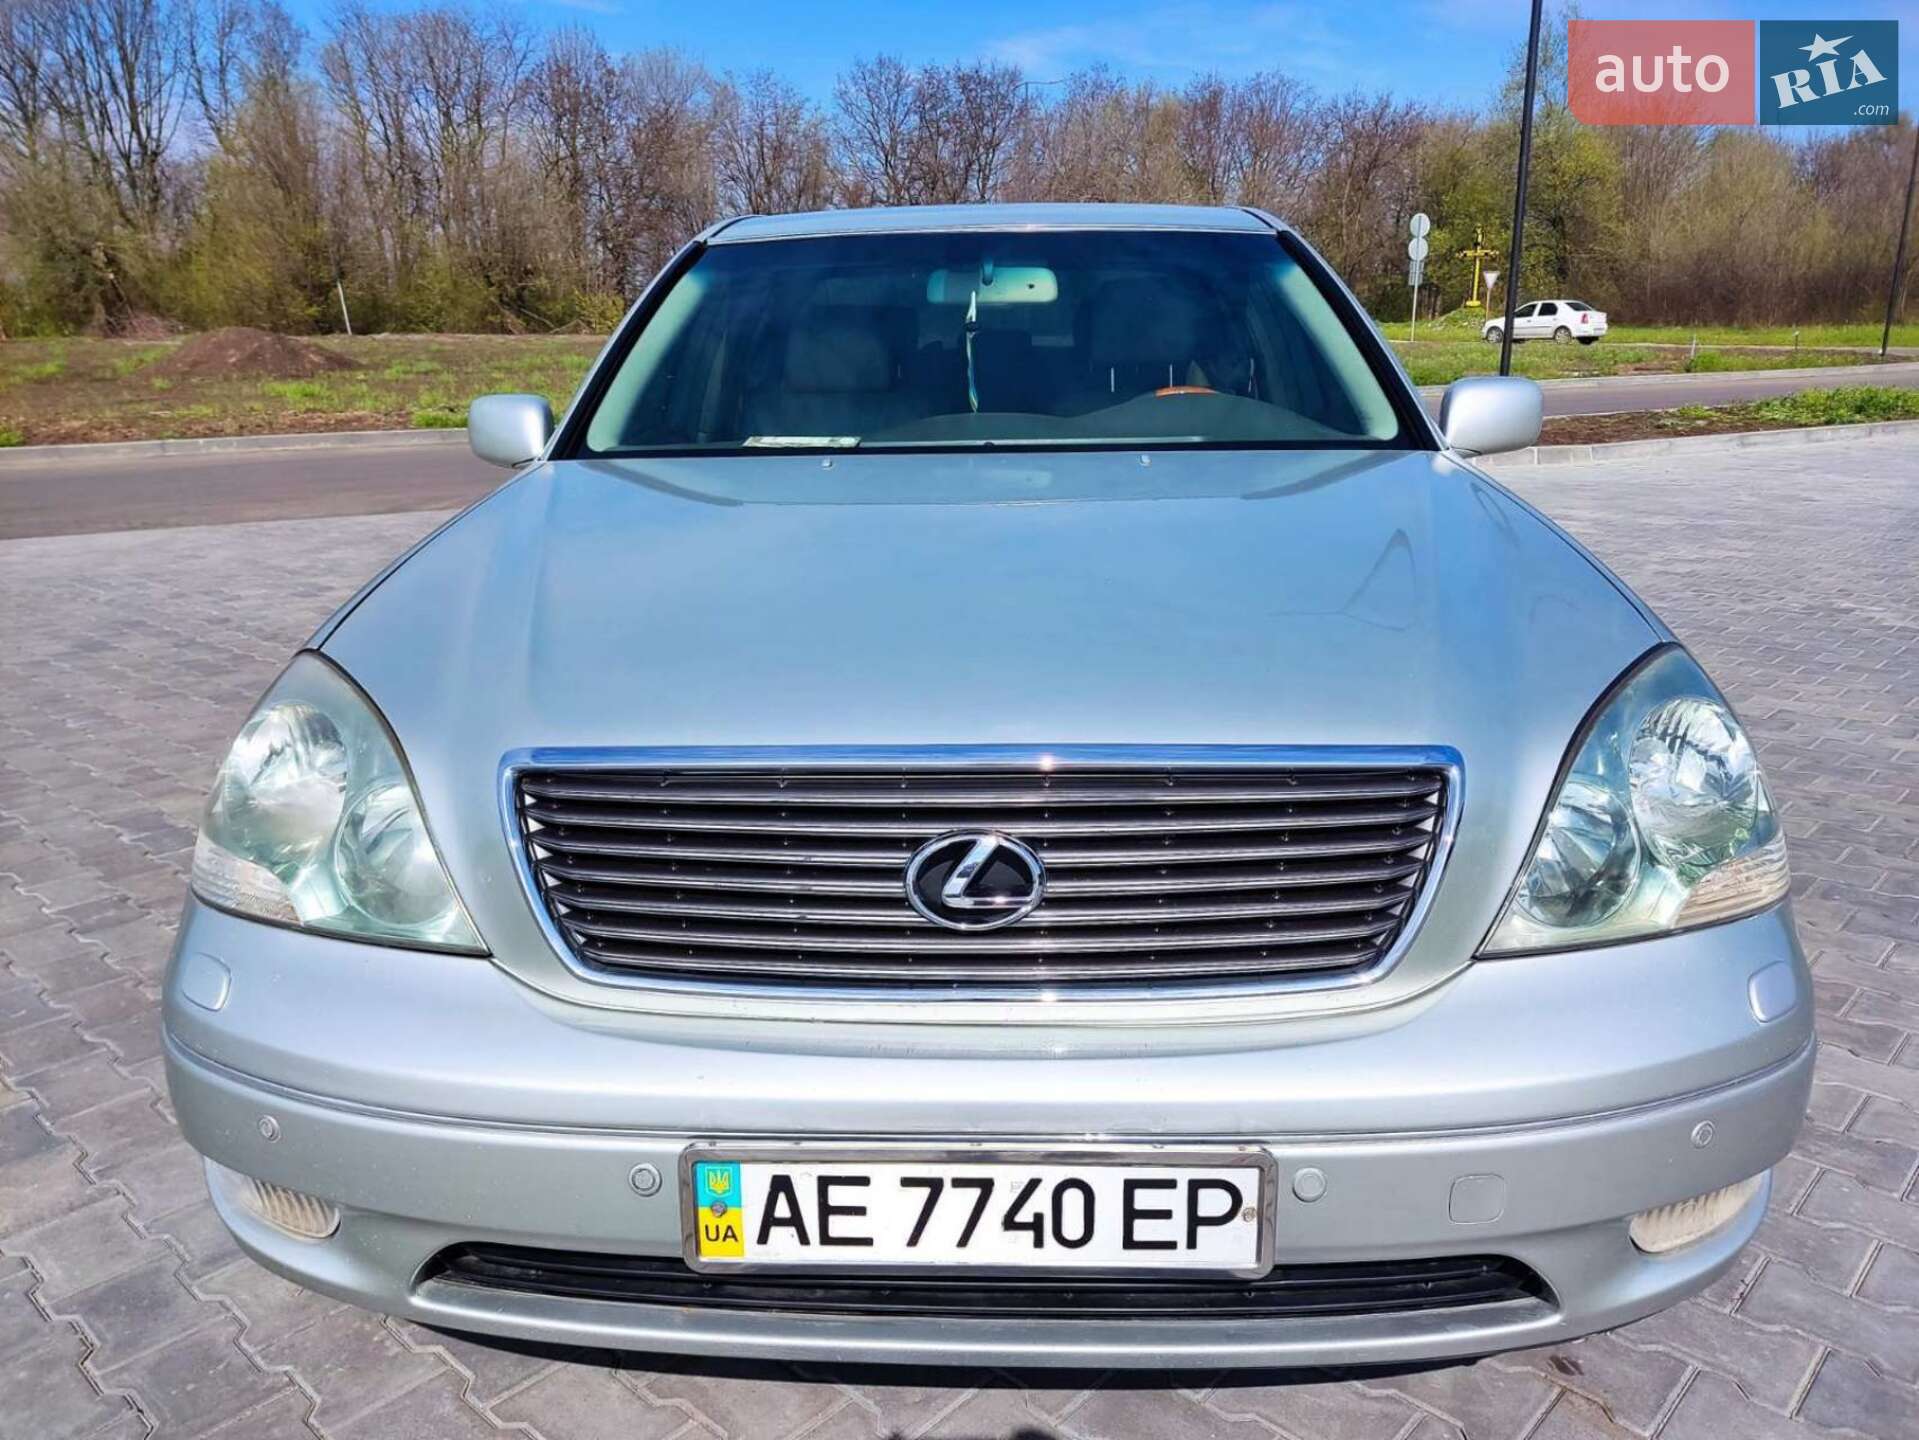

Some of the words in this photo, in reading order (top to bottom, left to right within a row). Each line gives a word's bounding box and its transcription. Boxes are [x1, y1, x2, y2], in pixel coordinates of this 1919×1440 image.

[704, 1224, 739, 1243] UA
[756, 1174, 875, 1247] AE
[900, 1176, 1096, 1249] 7740
[1122, 1178, 1244, 1250] EP
